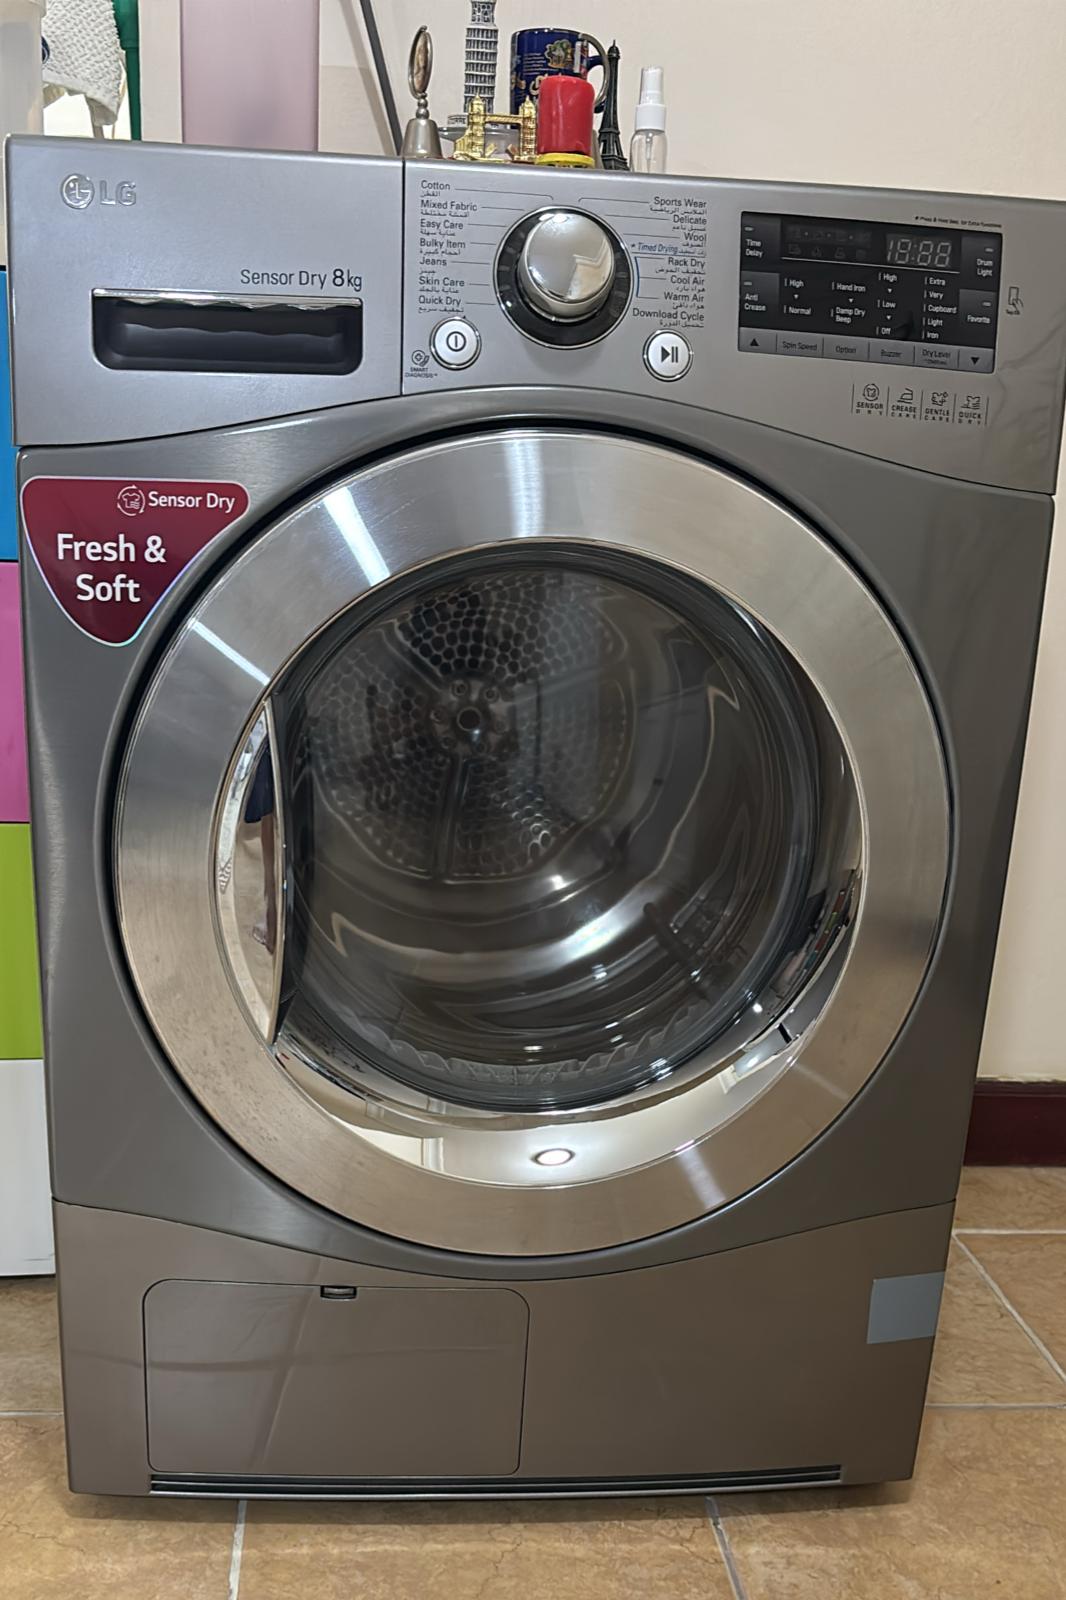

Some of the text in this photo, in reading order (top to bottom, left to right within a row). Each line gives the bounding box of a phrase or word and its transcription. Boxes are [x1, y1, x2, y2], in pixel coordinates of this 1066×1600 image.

[421, 180, 450, 190] Cotton
[99, 179, 136, 206] LG
[420, 199, 478, 212] Mixed Fabric
[654, 196, 706, 208] Sports Wear
[420, 218, 464, 230] Easy Care
[673, 214, 707, 226] Delicate
[684, 232, 706, 242] Wool
[420, 238, 466, 249] Bulky Item
[638, 242, 658, 252] Timed
[658, 243, 678, 254] Drying
[746, 239, 762, 247] Time
[745, 249, 764, 258] Delay
[420, 257, 447, 266] Jeans
[668, 257, 706, 269] Rack Dry
[976, 258, 993, 266] Drum
[976, 268, 992, 277] Light
[240, 269, 295, 286] Sensor
[299, 270, 327, 290] Dry
[418, 276, 464, 287] Skin Care
[670, 275, 704, 286] Cool Air
[883, 274, 898, 282] High
[929, 278, 946, 286] Extra
[789, 280, 804, 288] High
[836, 284, 853, 292] Hand
[664, 292, 704, 302] Warm Air
[744, 293, 758, 301] Anti
[929, 291, 944, 300] Very
[418, 295, 461, 307] Quick Dry
[744, 303, 766, 312] Crease
[788, 306, 812, 315] Normal
[836, 306, 866, 317] Damp Dry
[928, 304, 957, 314] Cupboard
[632, 308, 704, 322] Download Cycle
[836, 315, 852, 324] Beep
[967, 314, 990, 324] Favorite
[928, 319, 943, 327] Light
[782, 341, 818, 351] Spin Speed
[835, 345, 856, 354] Option
[922, 350, 934, 358] Dry
[856, 402, 884, 410] SENSOR
[891, 405, 916, 413] CREASE
[925, 408, 950, 416] GENTLE
[148, 491, 235, 513] Sensor Dry
[57, 533, 167, 563] Fresh &
[76, 573, 141, 603] Soft
